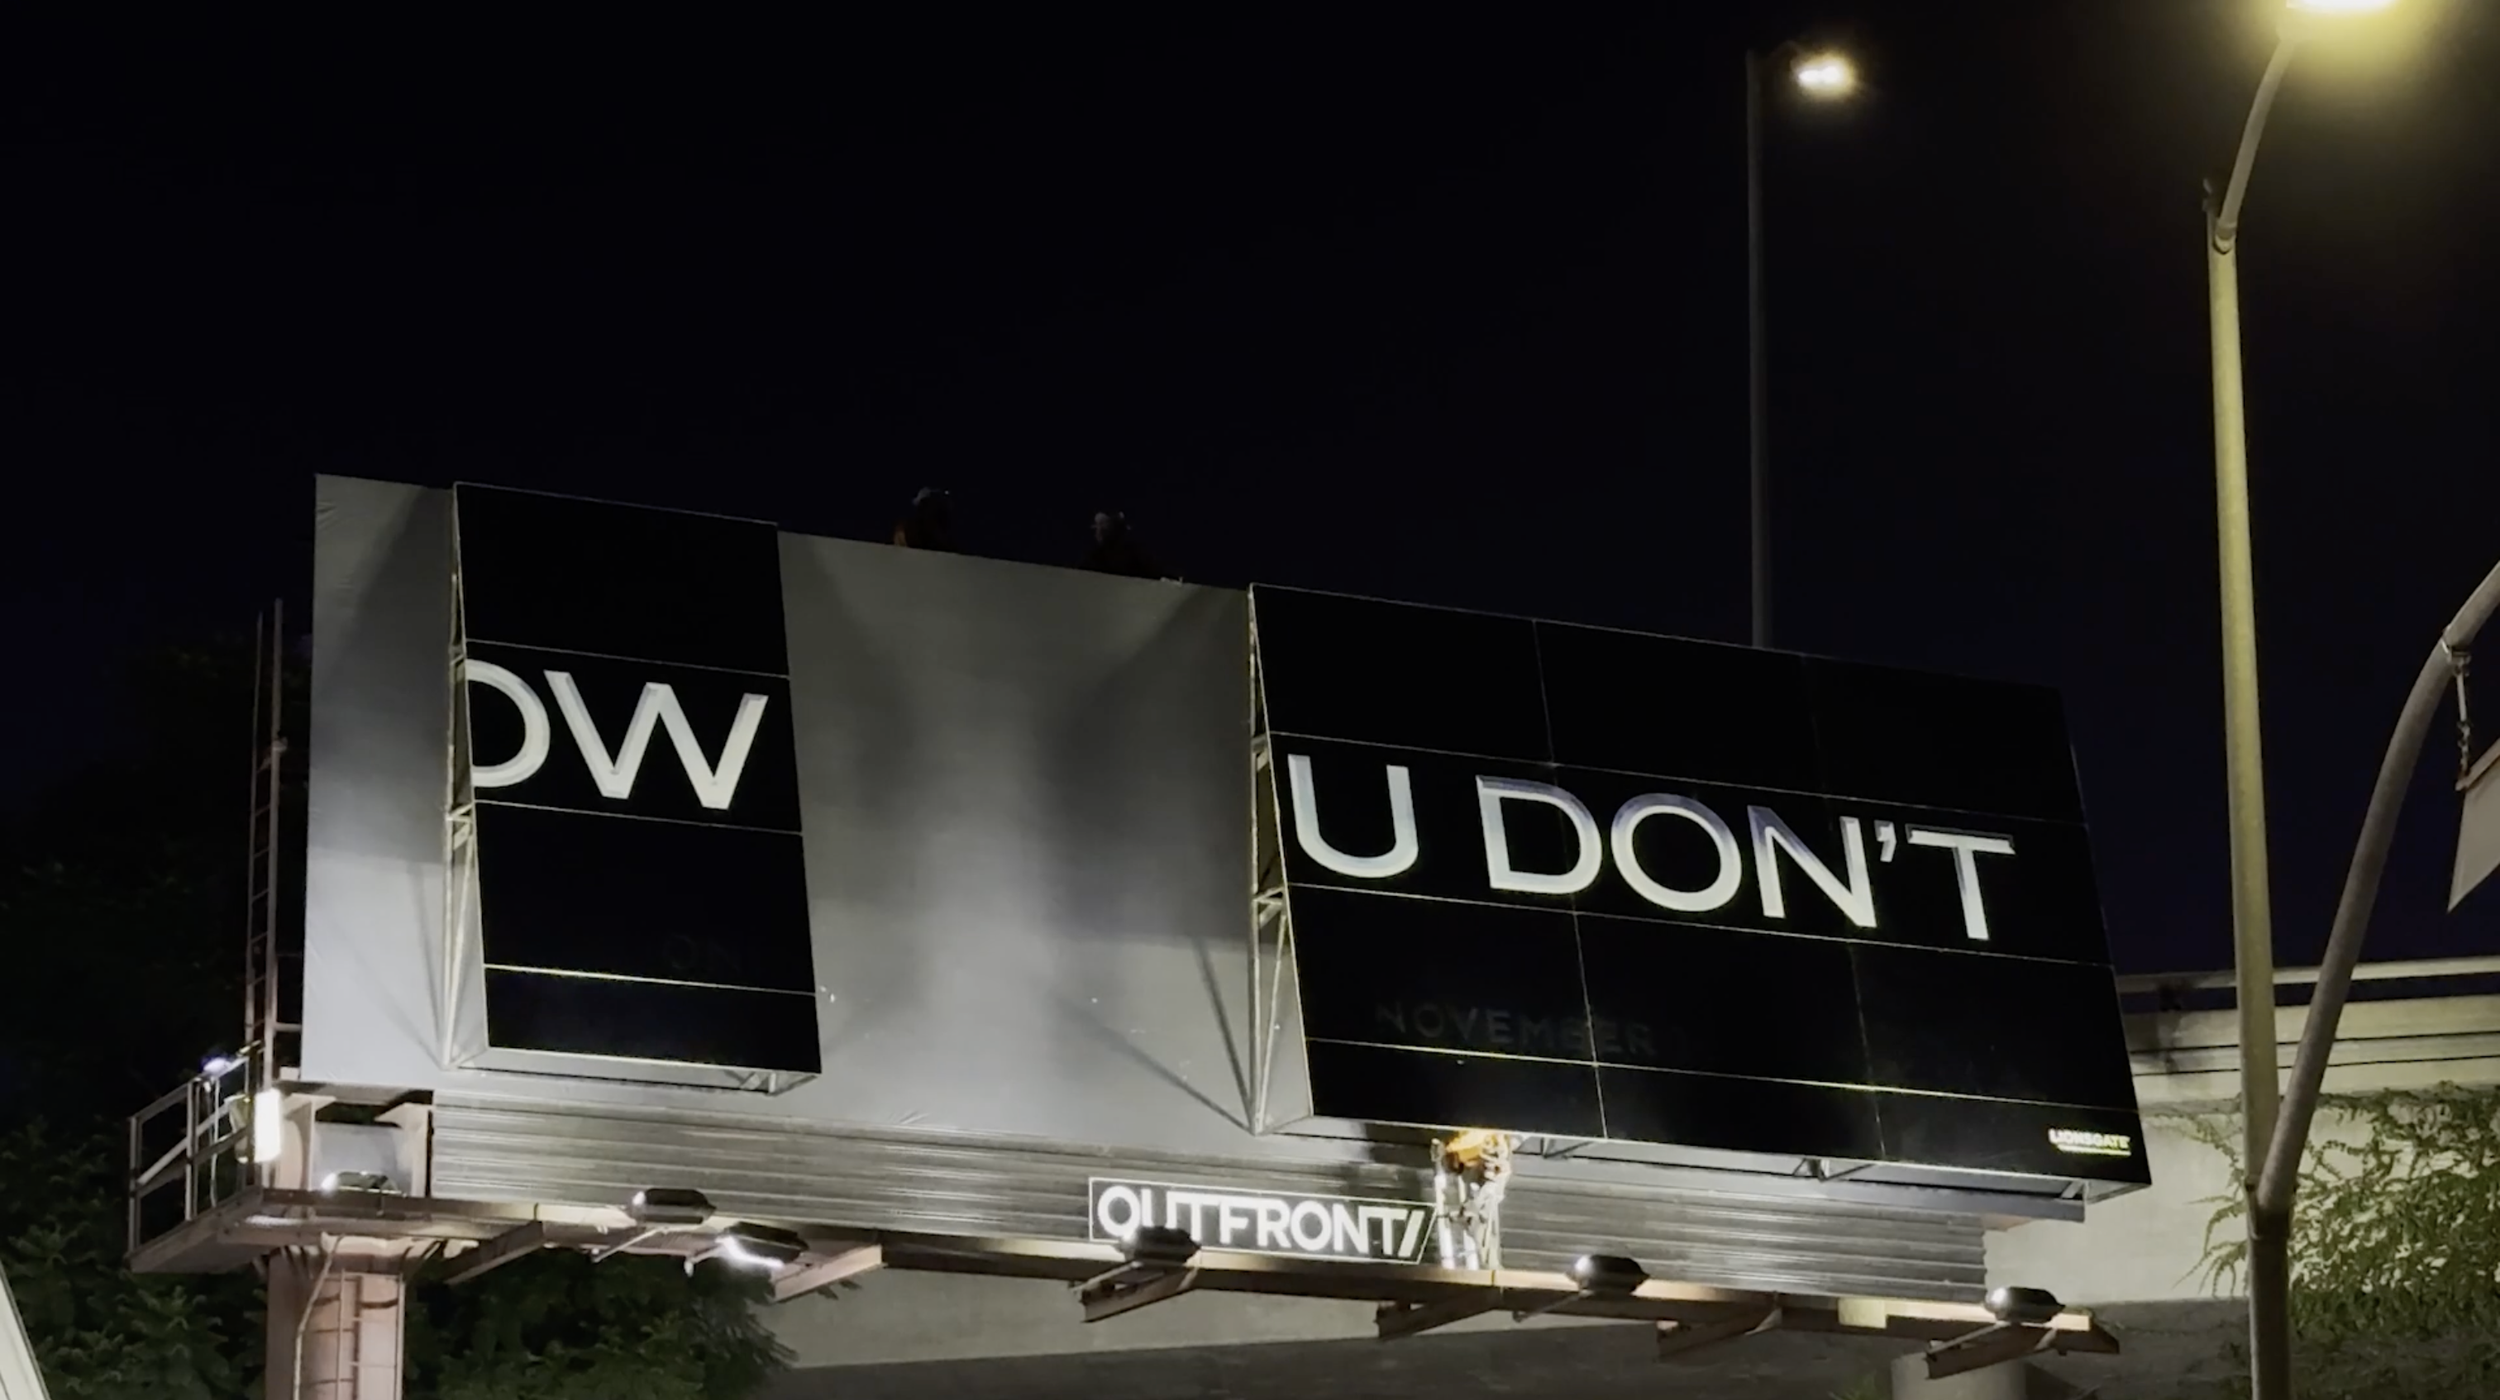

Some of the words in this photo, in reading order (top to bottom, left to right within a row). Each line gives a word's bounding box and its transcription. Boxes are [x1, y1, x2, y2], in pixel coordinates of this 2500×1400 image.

[1288, 754, 1418, 877] U
[1475, 775, 2016, 940] DON'T
[1375, 1001, 1656, 1057] NOVEMBER
